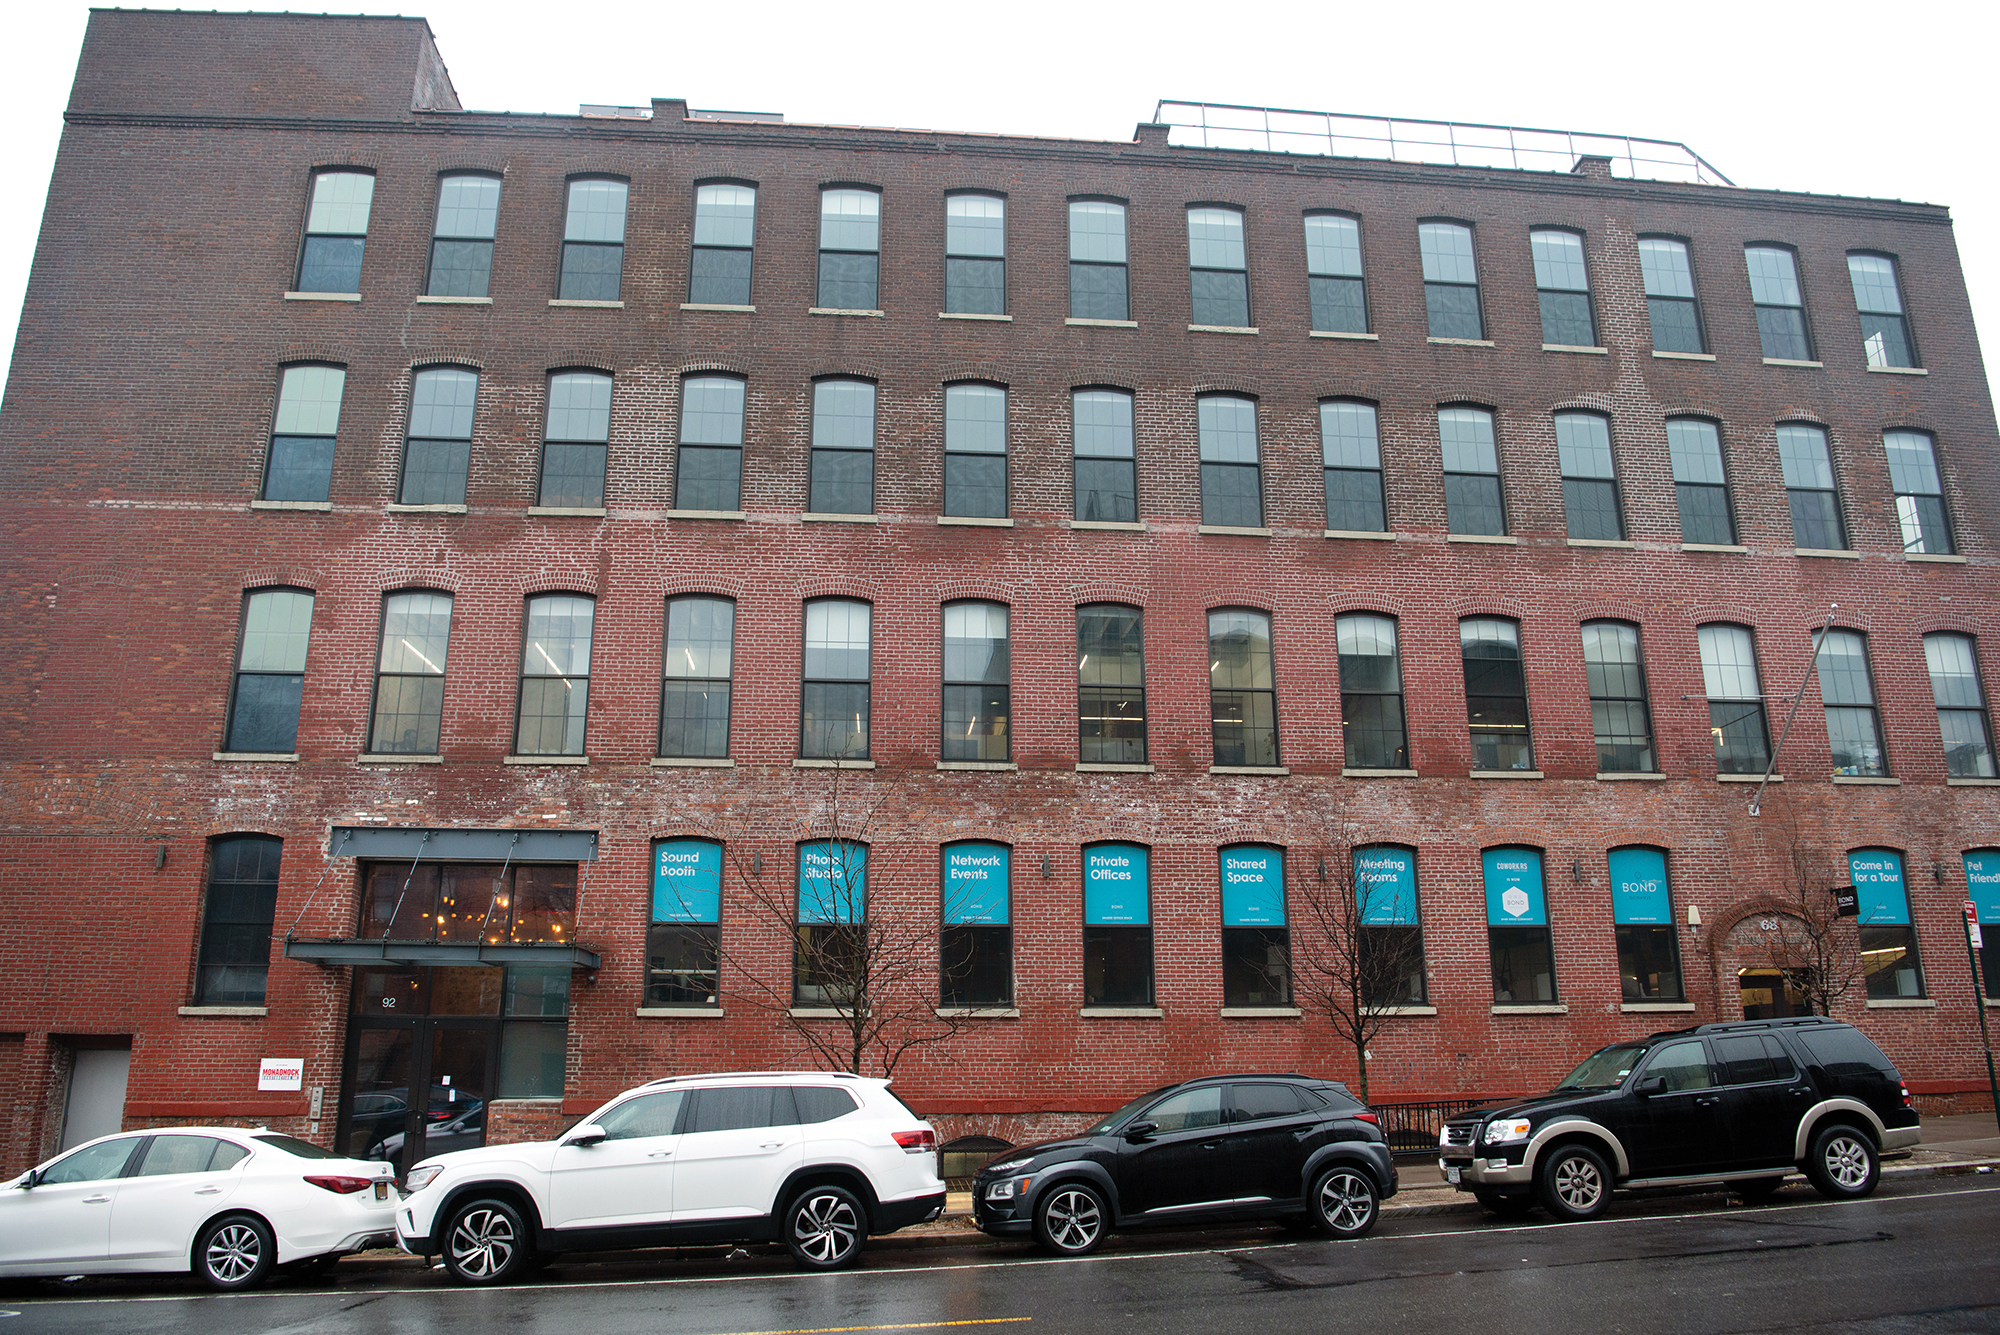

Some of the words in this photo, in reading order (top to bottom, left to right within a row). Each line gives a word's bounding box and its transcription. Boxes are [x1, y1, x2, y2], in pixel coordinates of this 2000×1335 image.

[661, 851, 699, 863] Sound
[806, 854, 840, 865] Photo
[951, 855, 1001, 866] Network
[1090, 856, 1130, 867] Private
[1226, 858, 1267, 869] Shared
[1360, 858, 1406, 872] Meeting
[1852, 860, 1882, 870] Come
[1884, 860, 1894, 870] in
[1967, 861, 1983, 871] Pet
[660, 865, 696, 877] Booth
[805, 867, 843, 879] Studio
[950, 868, 989, 880] Events
[1090, 869, 1132, 880] Offices
[1227, 871, 1264, 885] Space
[1360, 872, 1398, 882] Rooms
[1855, 872, 1868, 882] for
[1870, 874, 1877, 882] a
[1879, 872, 1899, 882] Tour
[1622, 882, 1657, 893] BOND
[1837, 895, 1854, 903] BOND
[1760, 919, 1778, 931] 68
[382, 997, 396, 1008] 92
[262, 1068, 300, 1076] MONADNOCK
